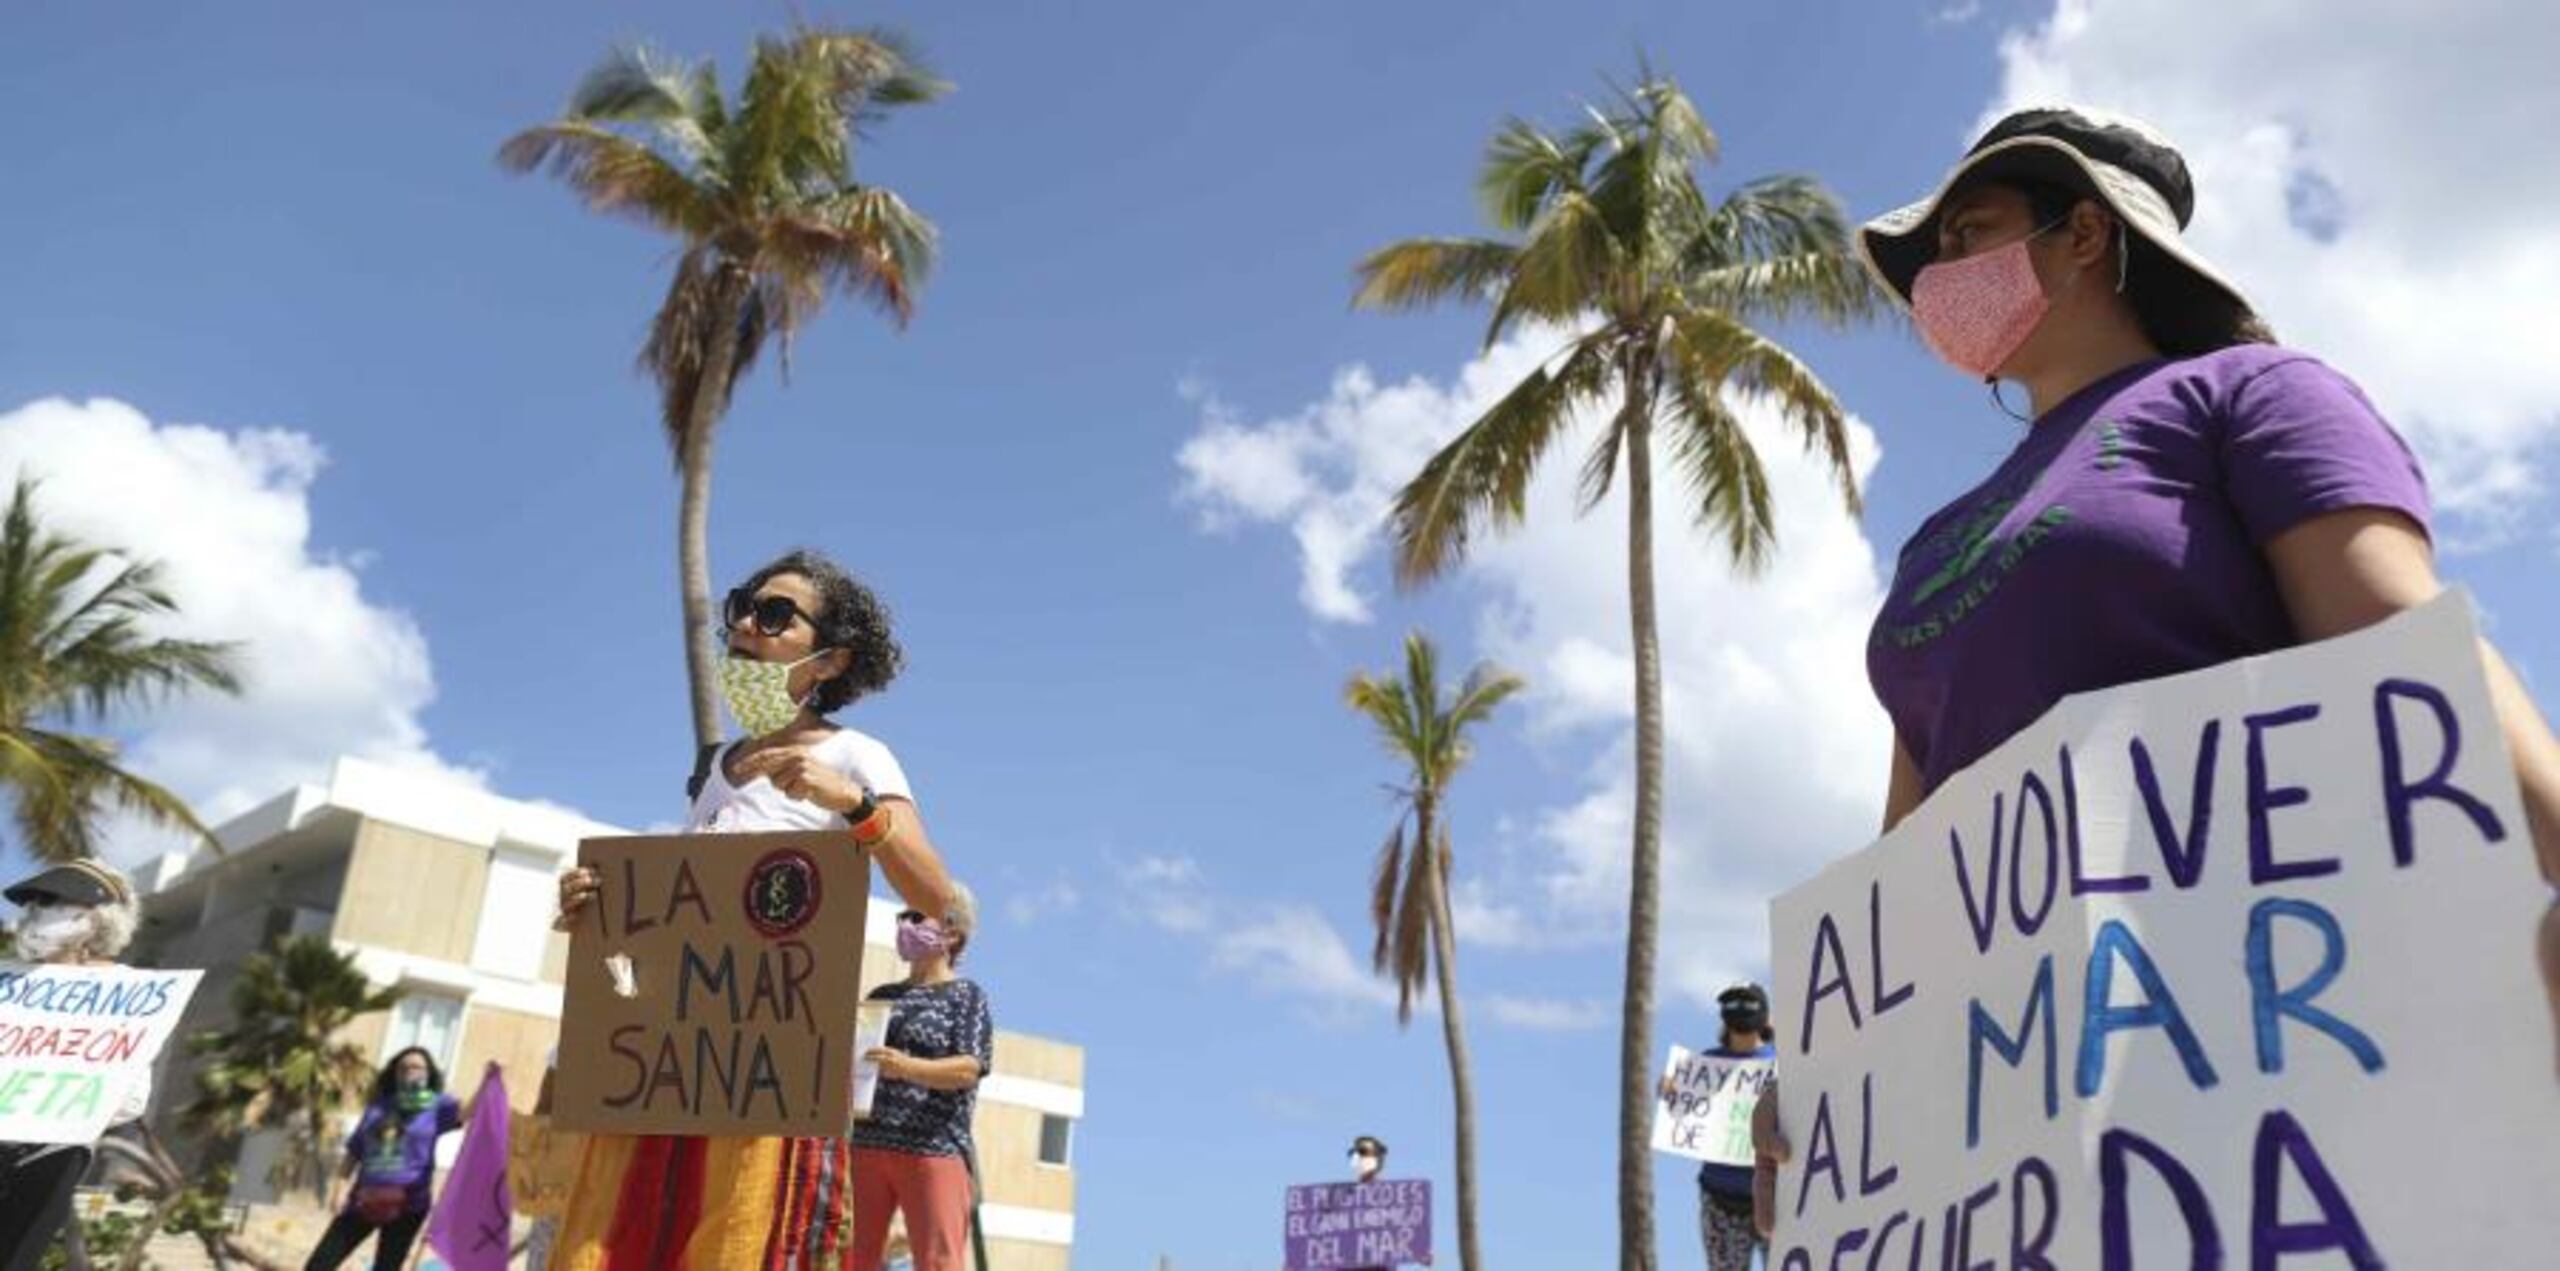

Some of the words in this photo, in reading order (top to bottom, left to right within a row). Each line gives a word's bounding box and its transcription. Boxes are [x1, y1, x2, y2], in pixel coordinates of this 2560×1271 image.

[1800, 880, 1915, 1056] AL
[1950, 677, 2507, 956] VOLVER
[676, 941, 817, 1034] MAR
[1674, 1059, 1733, 1093] HAY
[1797, 1073, 1898, 1218] AL
[1965, 896, 2387, 1149] MAR
[1288, 1214, 1308, 1238] EL
[1780, 1109, 2388, 1271] CUERDA
[1306, 1236, 1345, 1266] DEL
[1356, 1227, 1414, 1265] MAR
